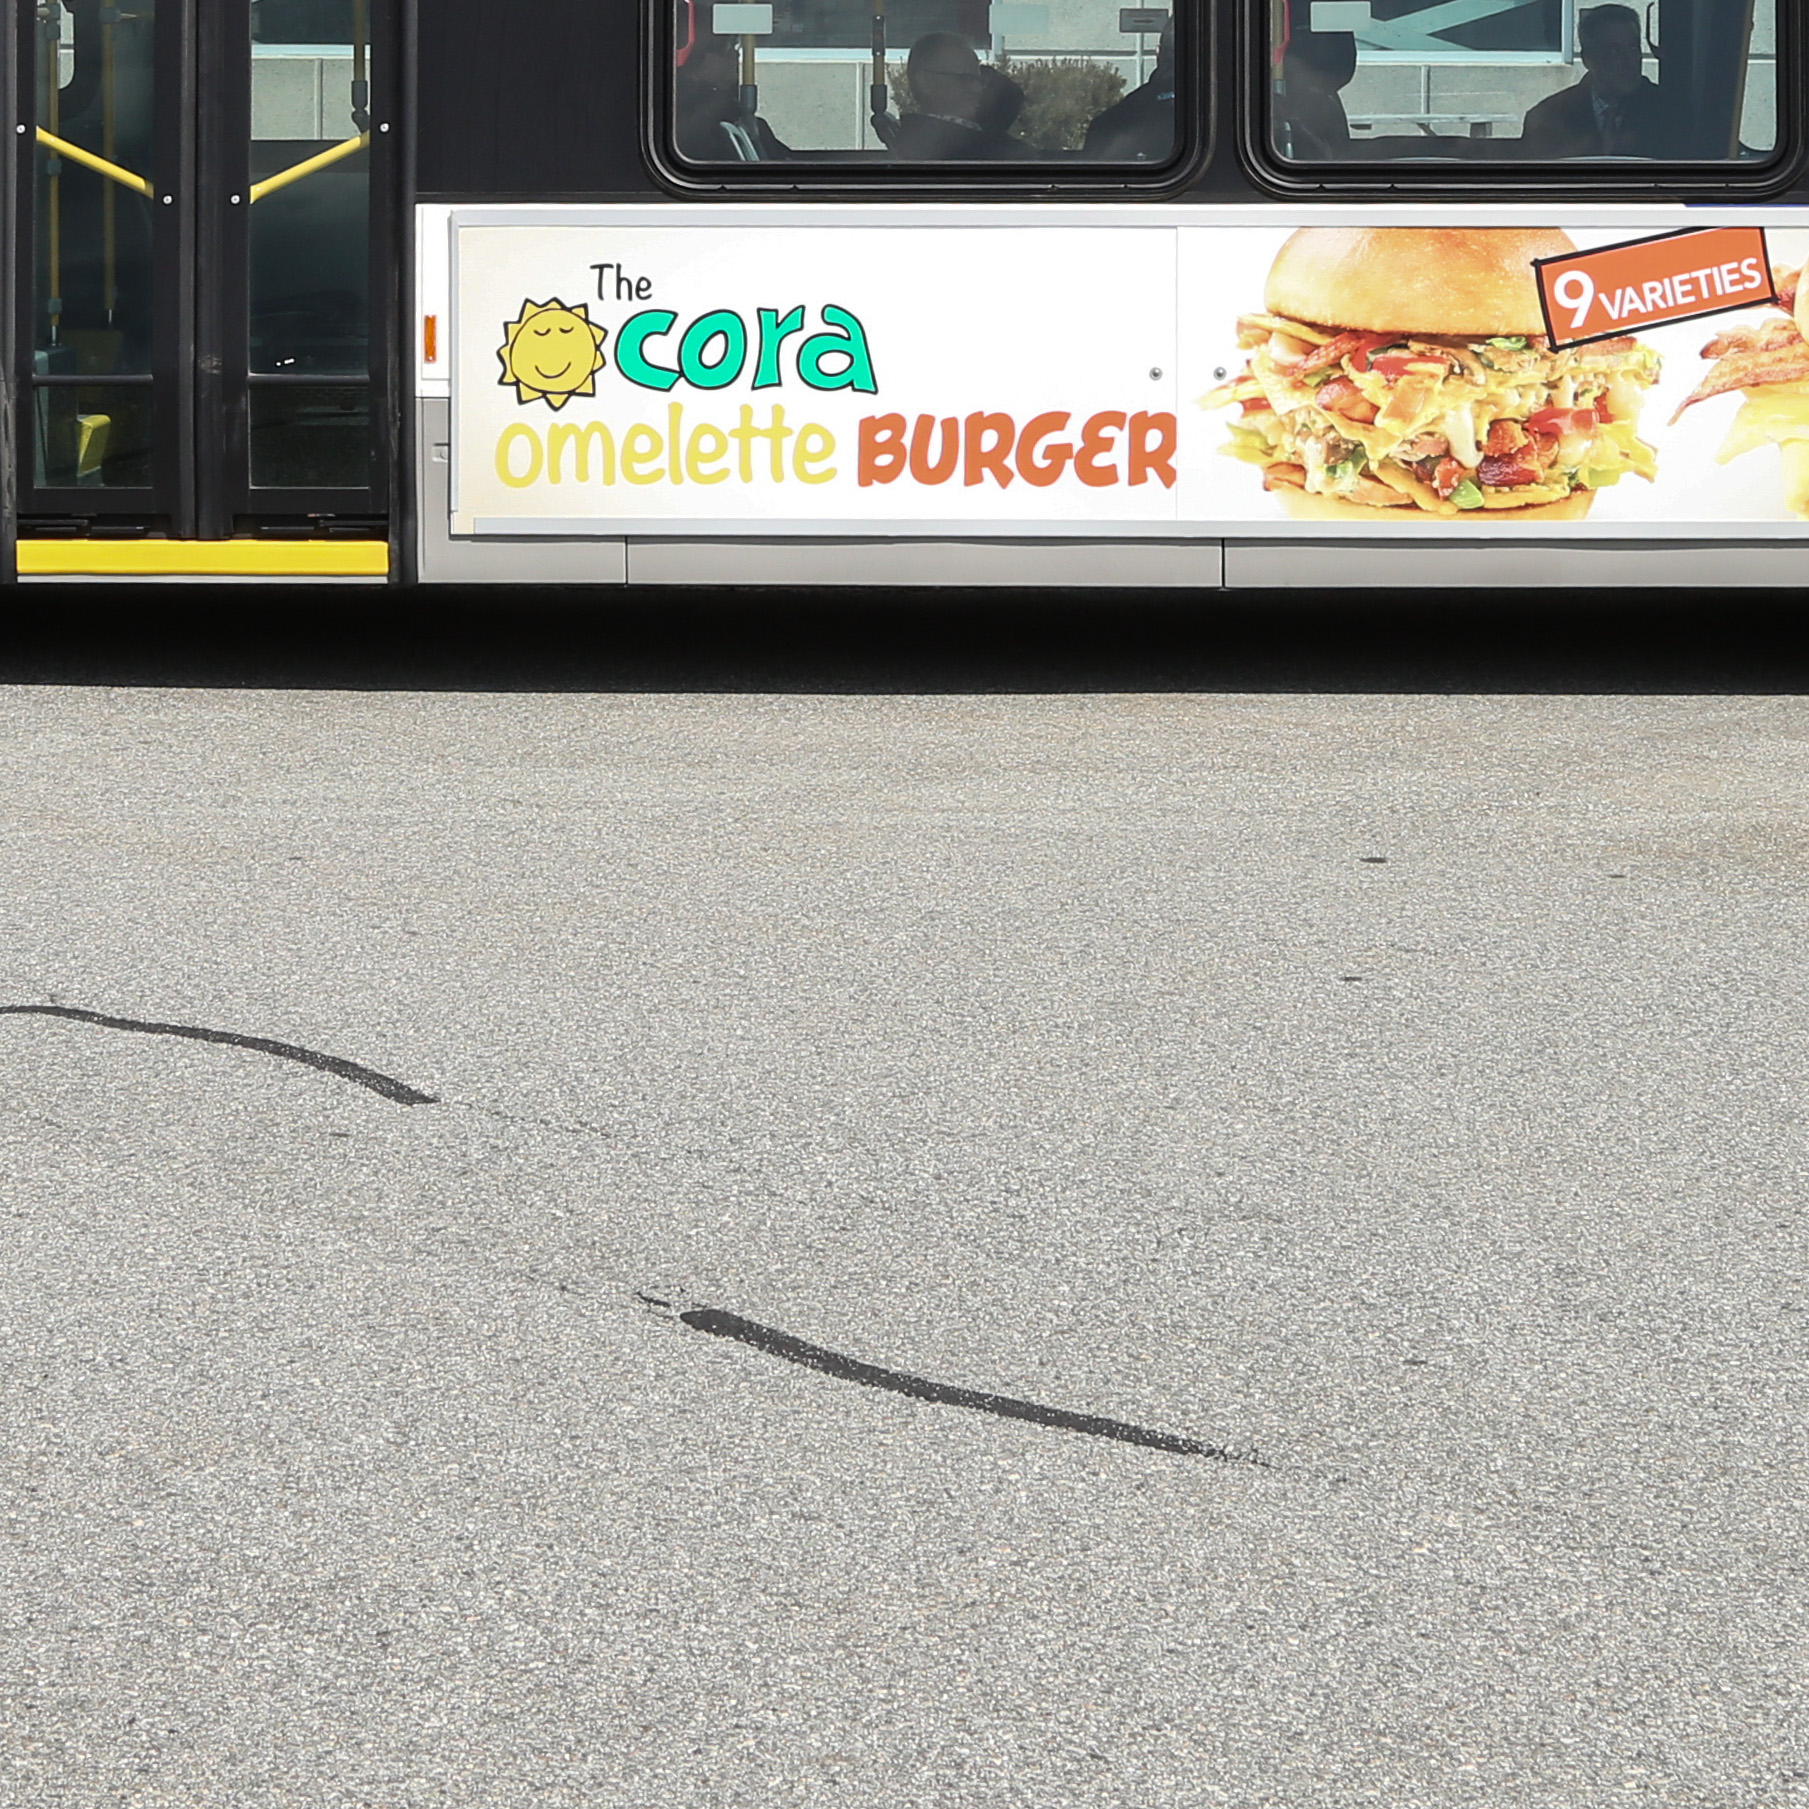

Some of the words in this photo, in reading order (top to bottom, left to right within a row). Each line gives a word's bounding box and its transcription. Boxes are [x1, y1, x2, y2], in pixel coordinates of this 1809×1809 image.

[589, 262, 653, 302] The
[1554, 270, 1595, 328] 9
[1597, 257, 1763, 320] VARIETIES
[614, 304, 878, 394] cora
[494, 401, 838, 489] omelette
[858, 409, 1177, 489] BURGER
